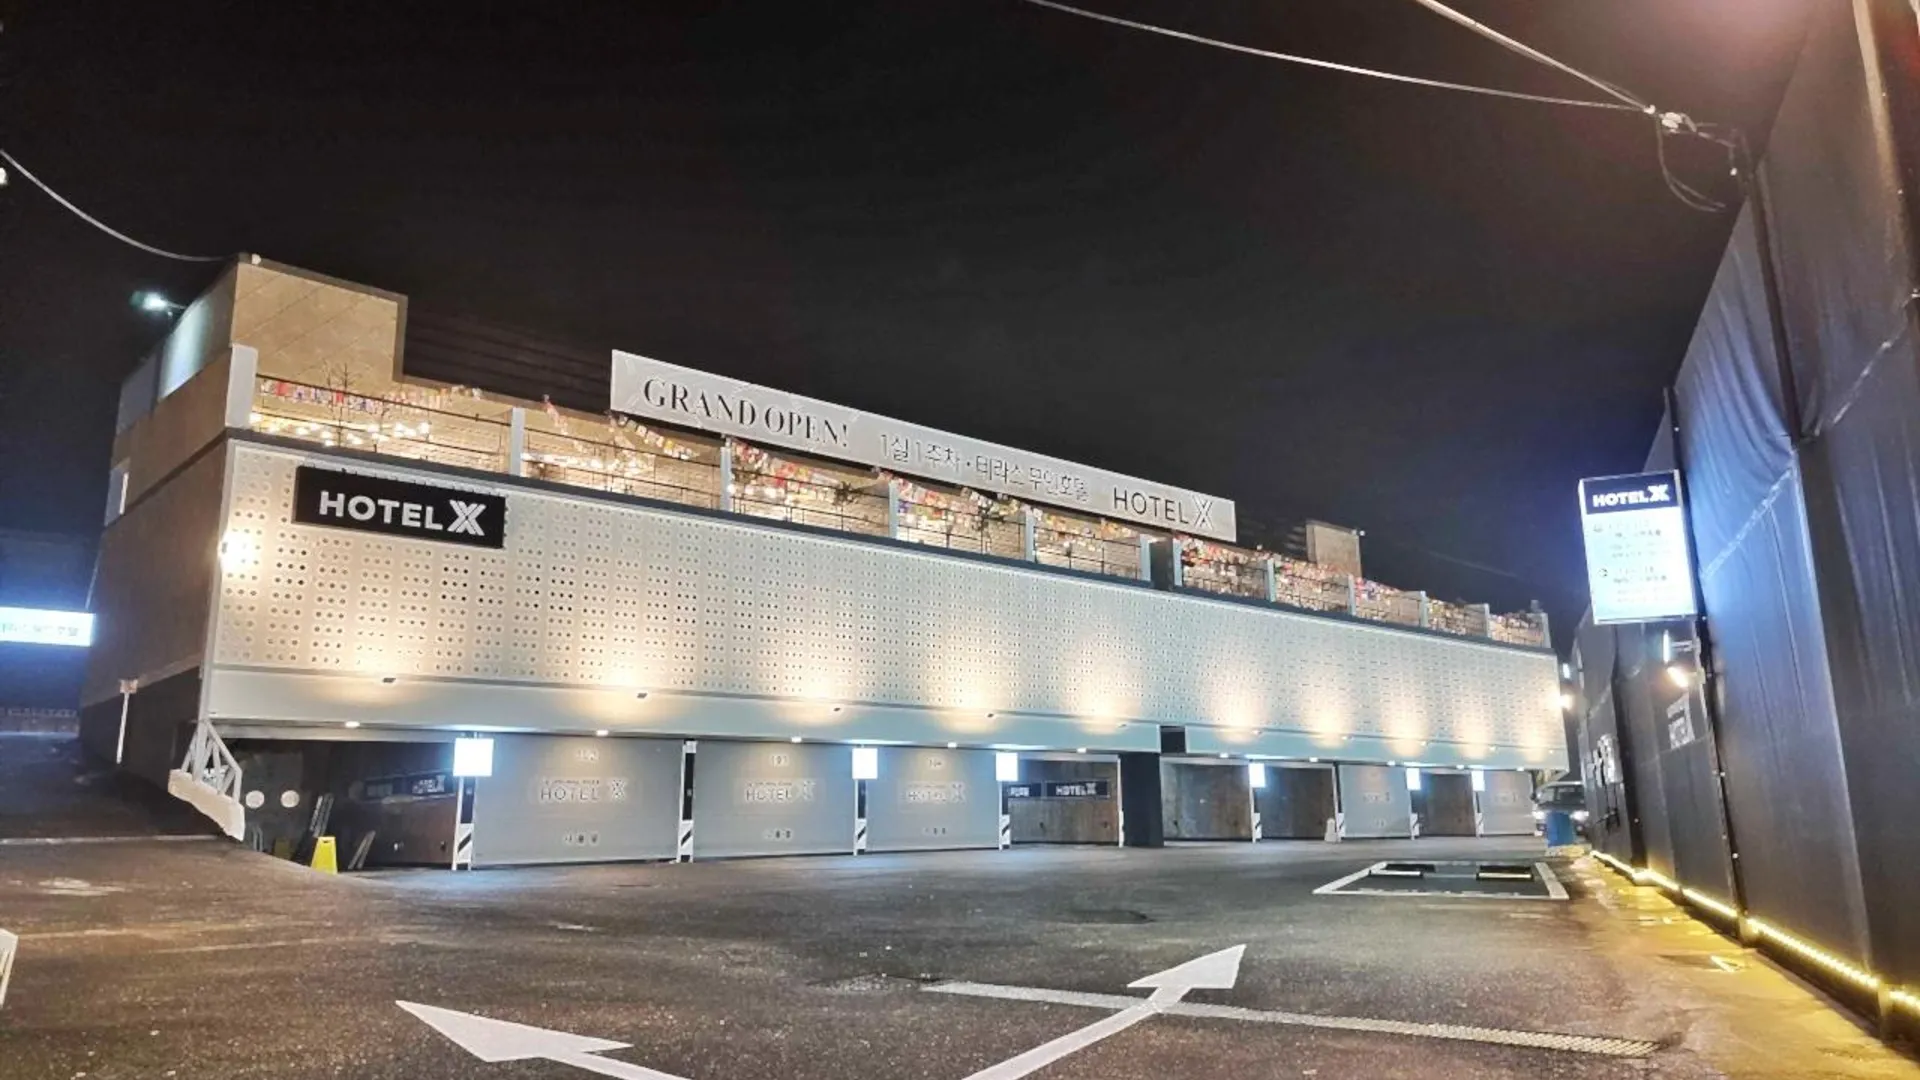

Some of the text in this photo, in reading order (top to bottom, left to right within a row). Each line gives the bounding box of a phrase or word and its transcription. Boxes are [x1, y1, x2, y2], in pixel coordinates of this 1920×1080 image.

[644, 379, 848, 447] GRAND OPEN!
[881, 434, 909, 463] 1실
[915, 441, 961, 472] 1주차
[318, 490, 487, 536] HOTEL X
[1113, 487, 1213, 530] HOTEL X
[1592, 490, 1649, 507] HOTEL
[540, 787, 600, 800] HOTEL
